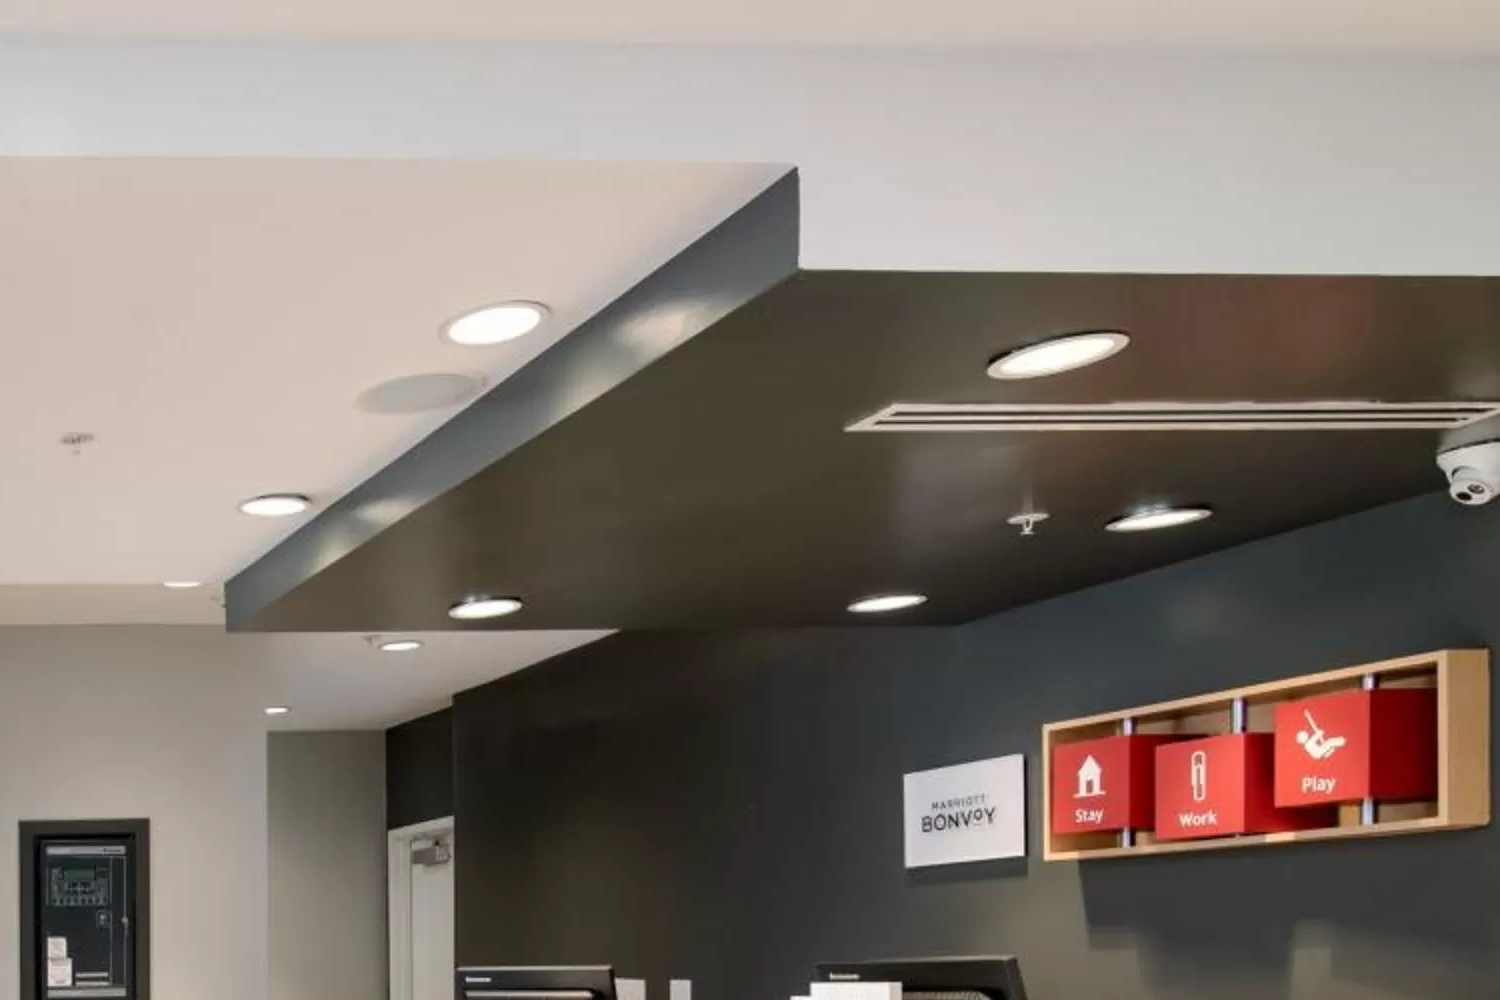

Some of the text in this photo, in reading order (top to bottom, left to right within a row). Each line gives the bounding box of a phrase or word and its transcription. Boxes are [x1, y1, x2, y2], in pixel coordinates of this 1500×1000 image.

[1301, 776, 1337, 794] Play
[931, 793, 986, 812] MARRIOTT
[921, 806, 996, 833] BONVOY
[1074, 808, 1104, 823] Stay
[1179, 811, 1217, 828] Work
